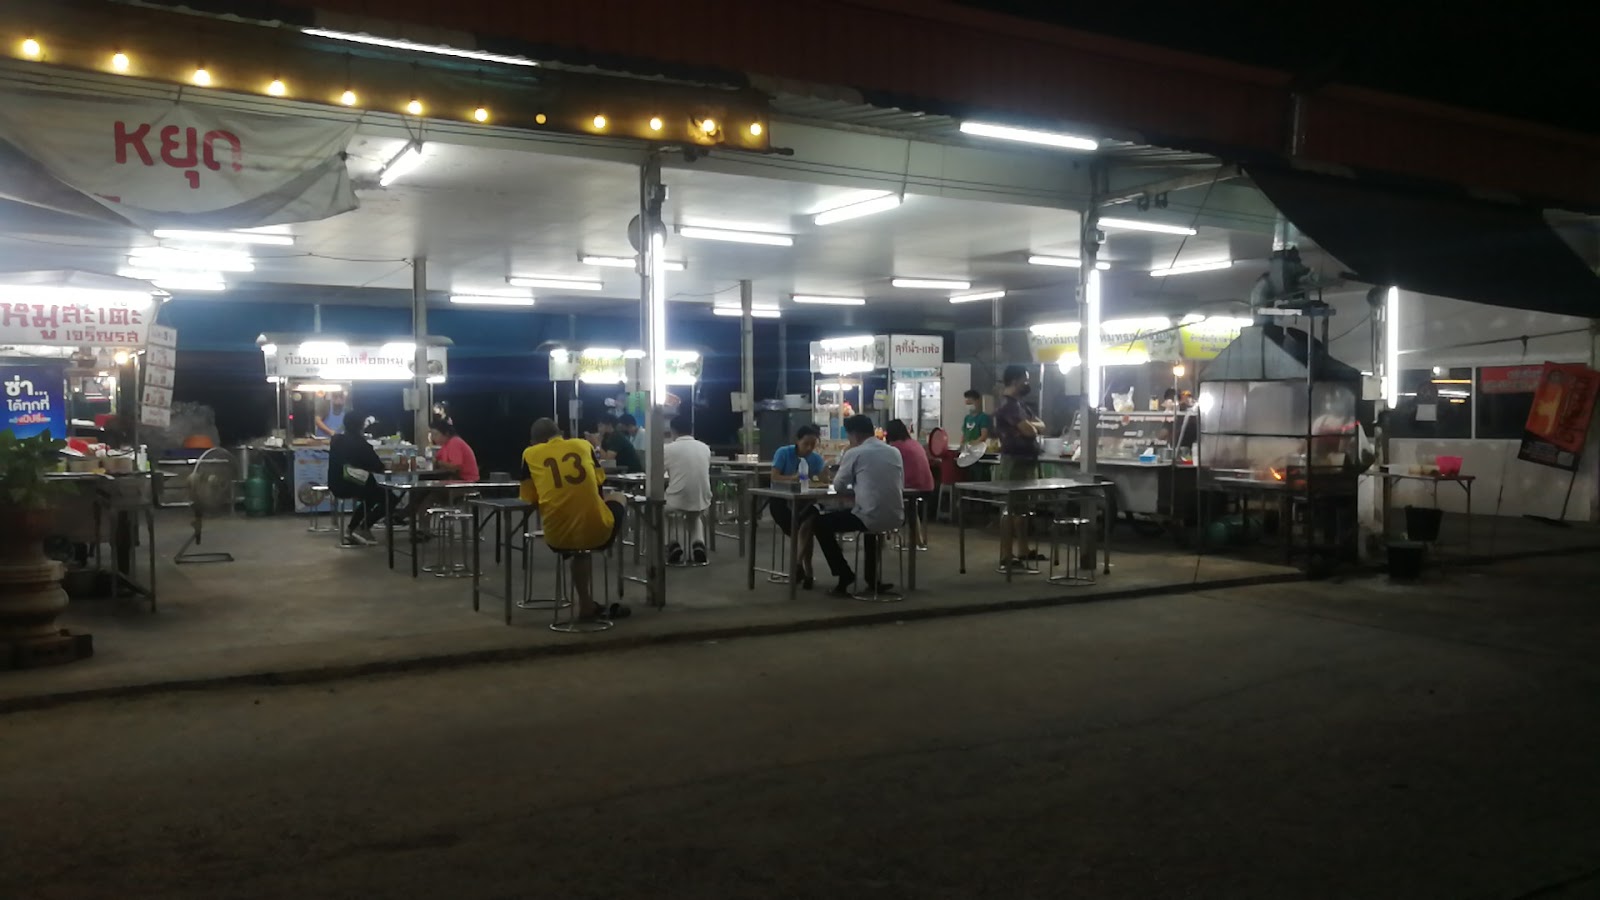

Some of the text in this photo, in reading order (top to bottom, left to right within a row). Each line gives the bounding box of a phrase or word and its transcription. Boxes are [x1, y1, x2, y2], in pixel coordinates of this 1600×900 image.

[114, 121, 242, 189] หยุด
[6, 395, 50, 413] ได้ทุกที่
[543, 452, 586, 489] 13
